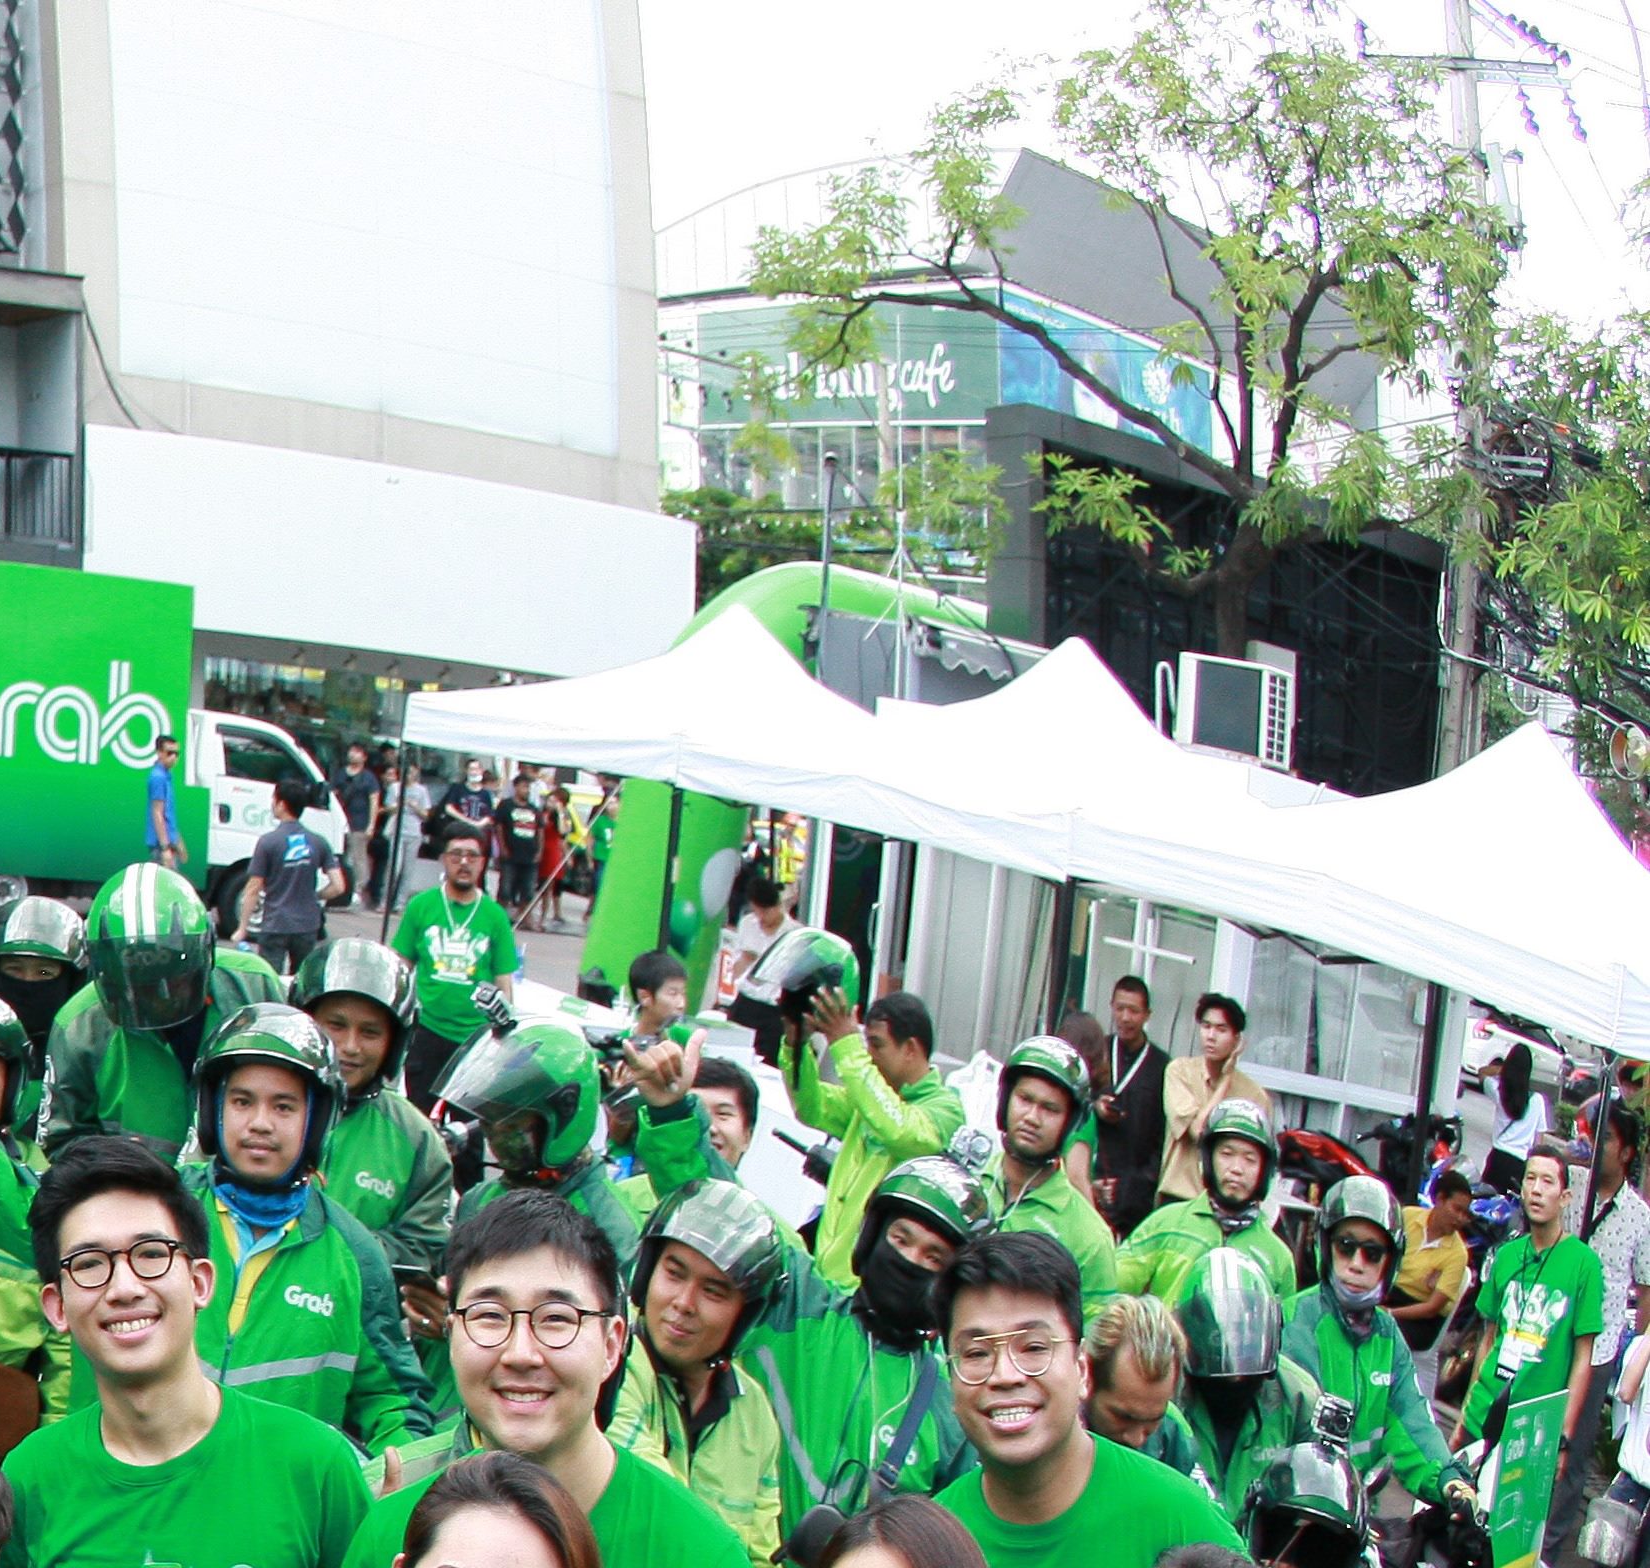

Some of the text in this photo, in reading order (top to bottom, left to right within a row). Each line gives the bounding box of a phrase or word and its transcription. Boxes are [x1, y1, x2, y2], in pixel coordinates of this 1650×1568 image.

[243, 802, 279, 828] Gr
[355, 1170, 396, 1200] Grab
[283, 1285, 334, 1317] Grab
